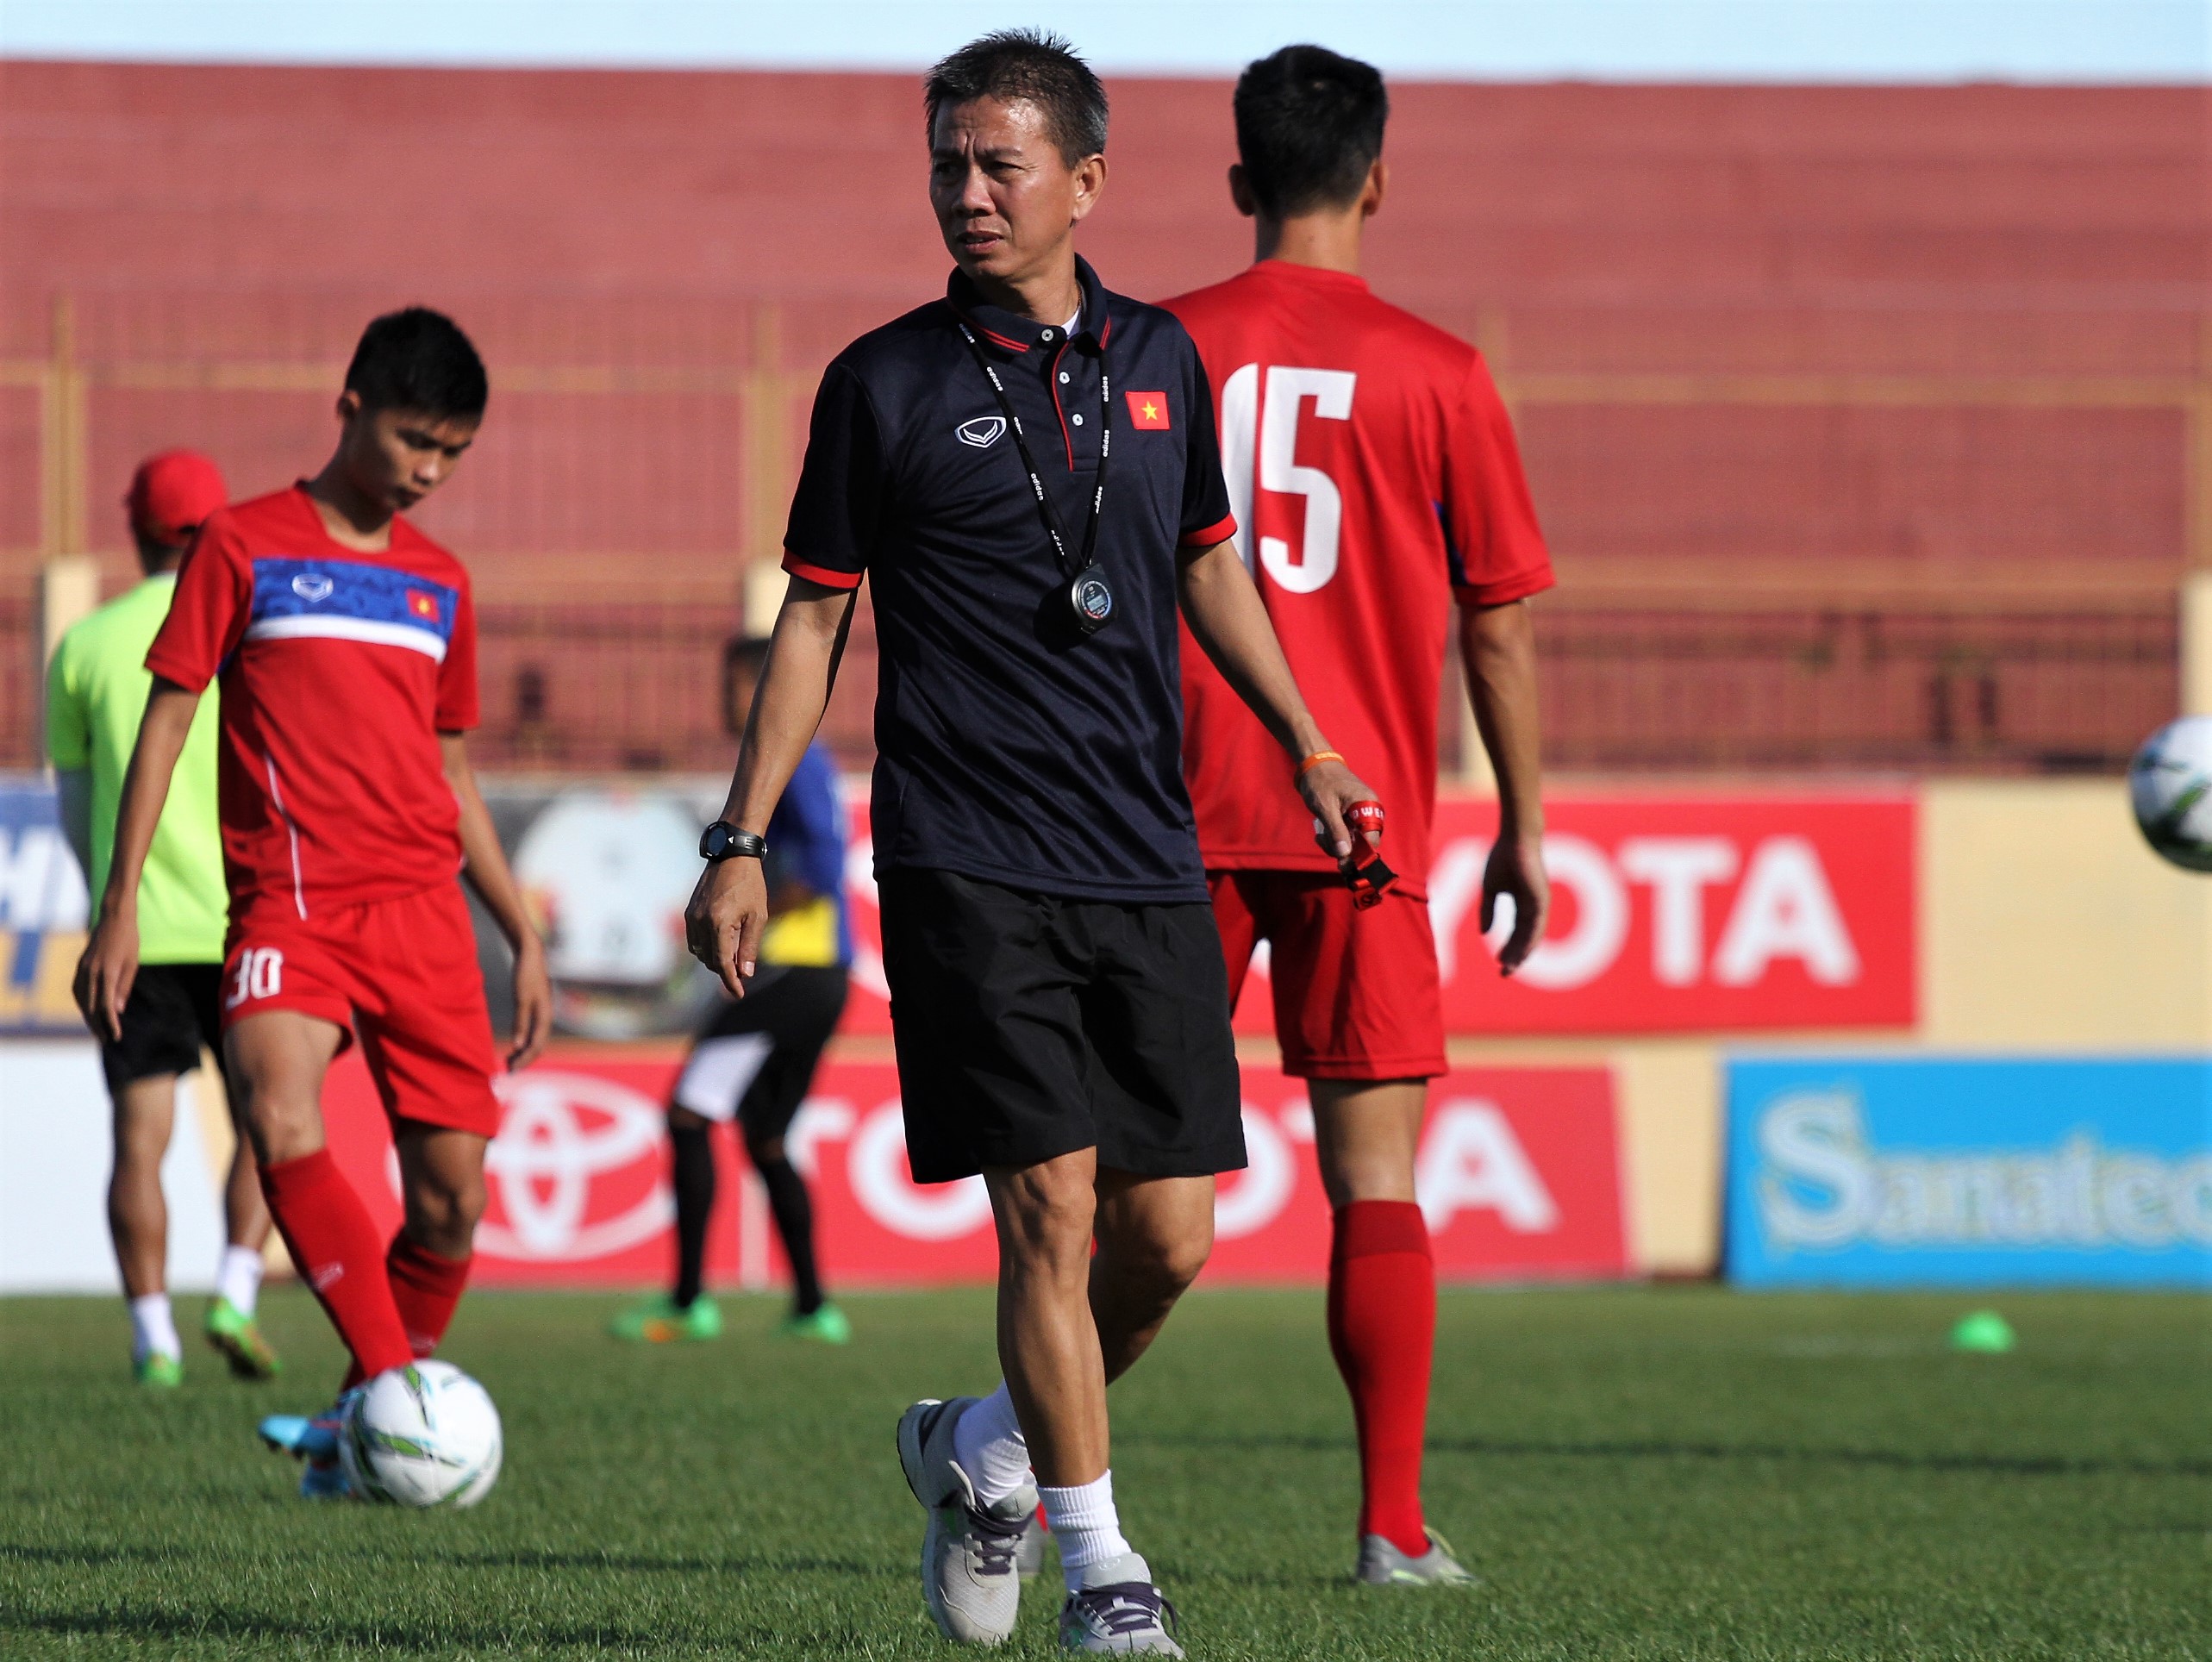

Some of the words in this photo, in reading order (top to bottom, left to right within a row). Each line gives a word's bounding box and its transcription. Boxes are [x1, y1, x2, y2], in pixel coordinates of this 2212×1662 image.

[986, 366, 1004, 391] adidas
[1102, 429, 1110, 458] adidas
[1030, 472, 1044, 501] adidas
[1221, 362, 1357, 594] 15
[1248, 832, 1862, 990] YOTA
[226, 947, 283, 1010] 30
